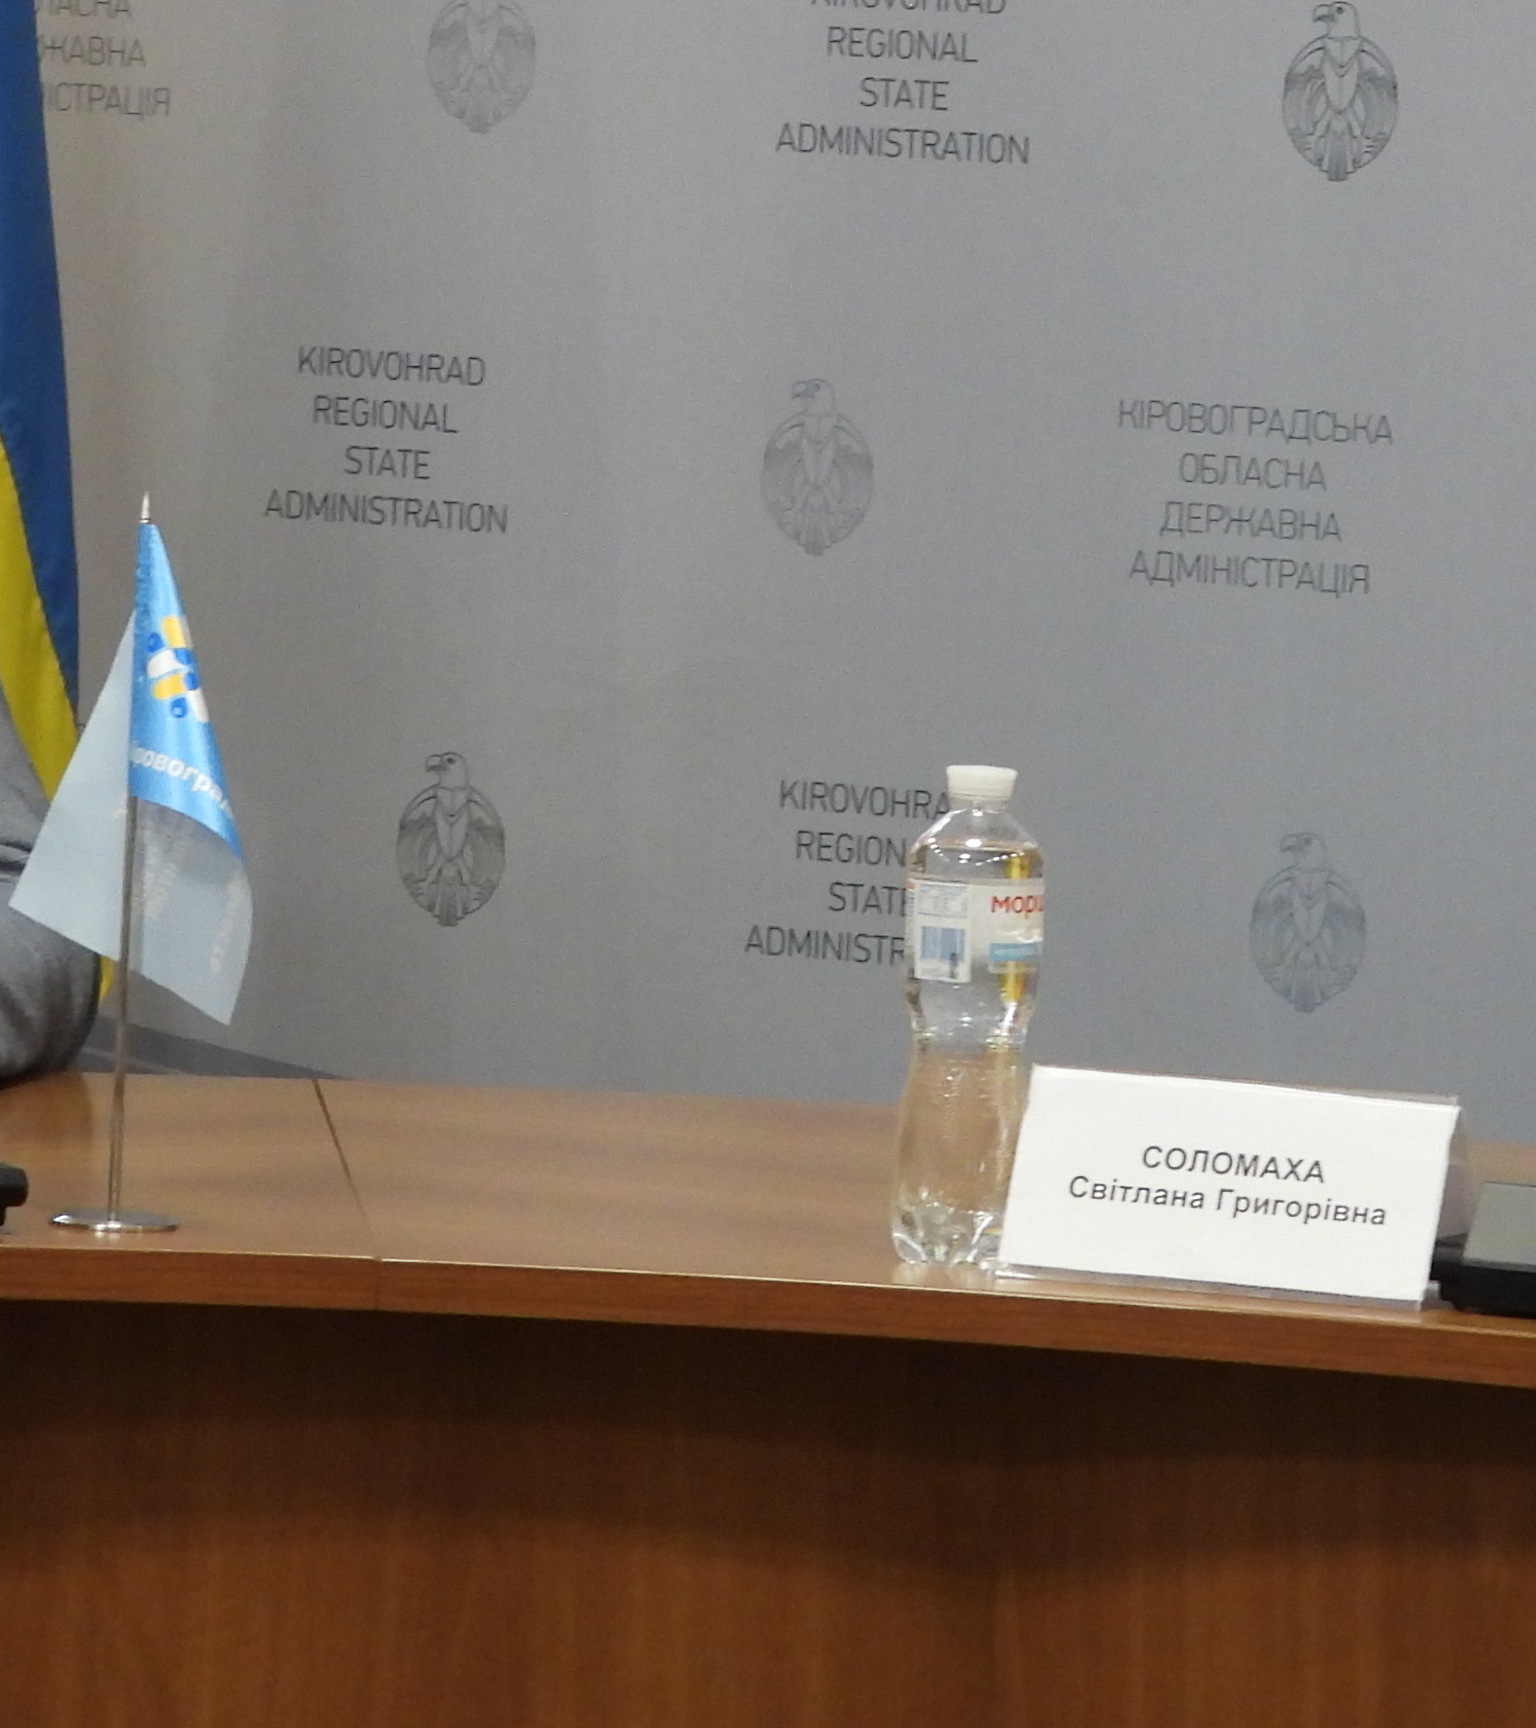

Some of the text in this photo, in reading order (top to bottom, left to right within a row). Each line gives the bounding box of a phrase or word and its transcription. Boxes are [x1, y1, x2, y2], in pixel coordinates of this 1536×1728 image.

[37, 35, 146, 68] ЖАВНА
[828, 26, 978, 63] REGIONAL
[860, 77, 949, 111] STATE
[776, 123, 1029, 164] ADMINISTRATION
[298, 346, 484, 386] KIROVOHRAD
[313, 394, 457, 433] REGIONAL
[1119, 399, 1392, 445] КІРОВОГРАДСЬКА
[344, 445, 430, 480] STATE
[1179, 452, 1326, 491] ОБЛАСНА
[264, 489, 506, 533] ADMINISTRATION
[1159, 501, 1341, 541] ДЕРЖАВНА
[1129, 550, 1369, 599] АДМІНІСТРАЦІЯ
[779, 779, 950, 821] KIROVOHRA
[796, 830, 906, 868] REGION
[745, 924, 905, 966] ADMINISTR
[1142, 1146, 1324, 1183] СОЛОМАХА
[1069, 1175, 1387, 1228] Світлана Григорівна
